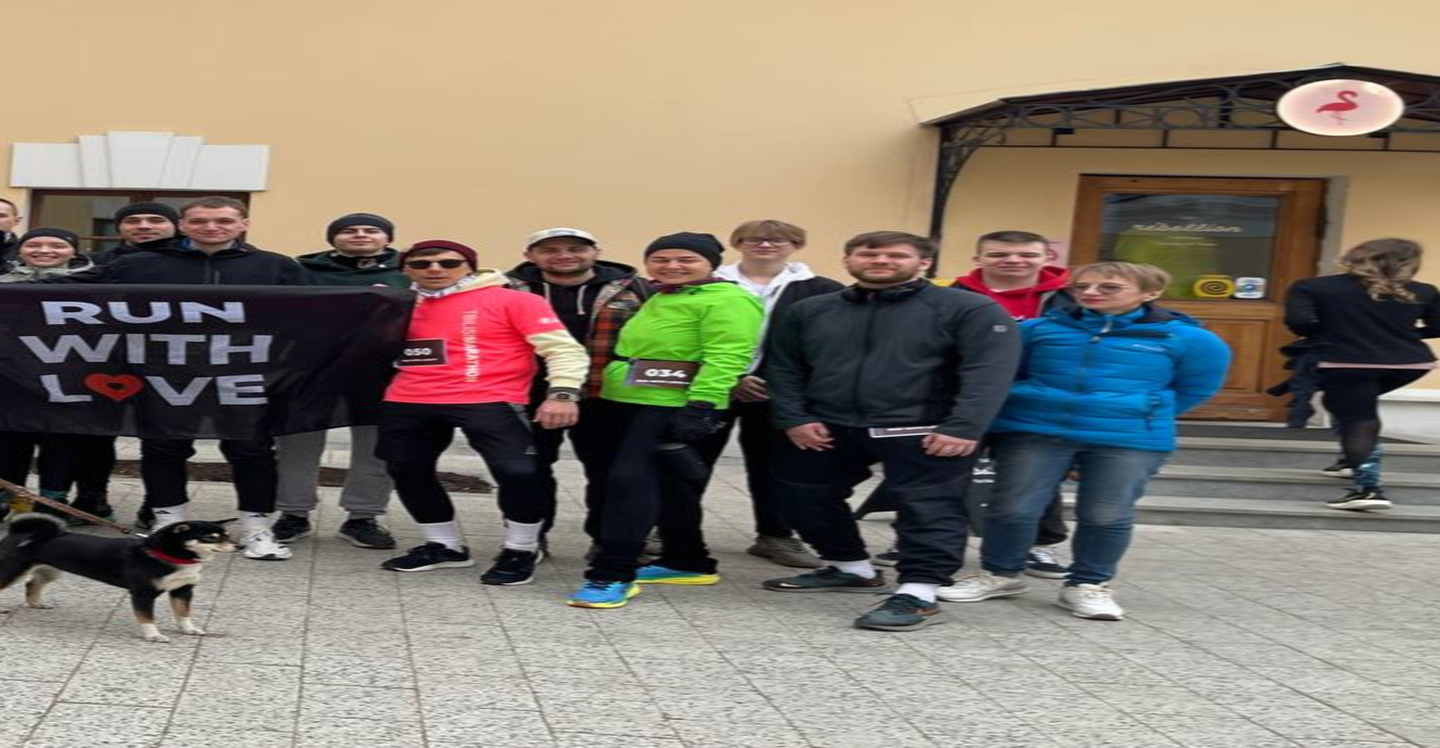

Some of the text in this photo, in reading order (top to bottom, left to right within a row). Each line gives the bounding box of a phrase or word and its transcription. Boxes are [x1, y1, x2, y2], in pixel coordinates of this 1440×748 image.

[41, 301, 246, 325] RUN
[18, 333, 273, 365] WITH
[404, 347, 432, 356] 050
[644, 368, 687, 378] 034
